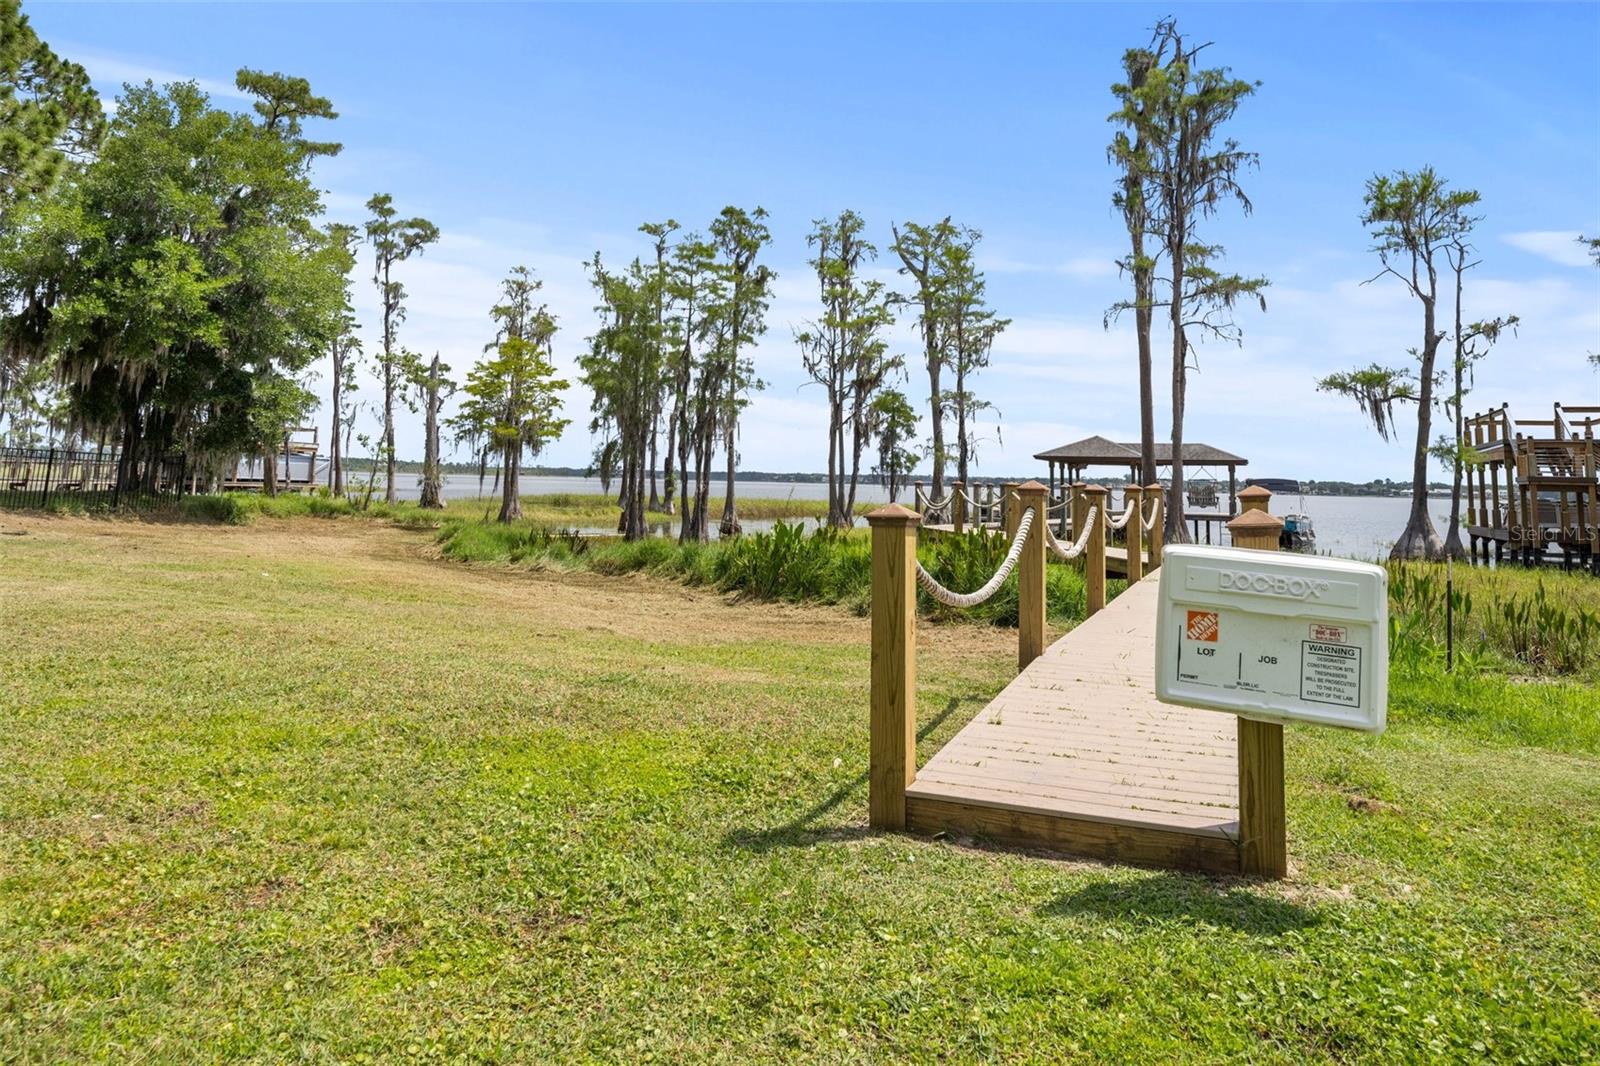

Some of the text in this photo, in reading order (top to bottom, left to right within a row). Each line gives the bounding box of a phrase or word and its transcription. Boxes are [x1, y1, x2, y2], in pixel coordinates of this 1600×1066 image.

[1197, 647, 1216, 657] LOT
[1308, 644, 1355, 656] WARNING
[1258, 655, 1278, 665] JOB
[1316, 657, 1346, 665] DESIGNATED
[1306, 662, 1343, 671] CONSTRUCTION
[1325, 679, 1356, 688] PROSECUTED
